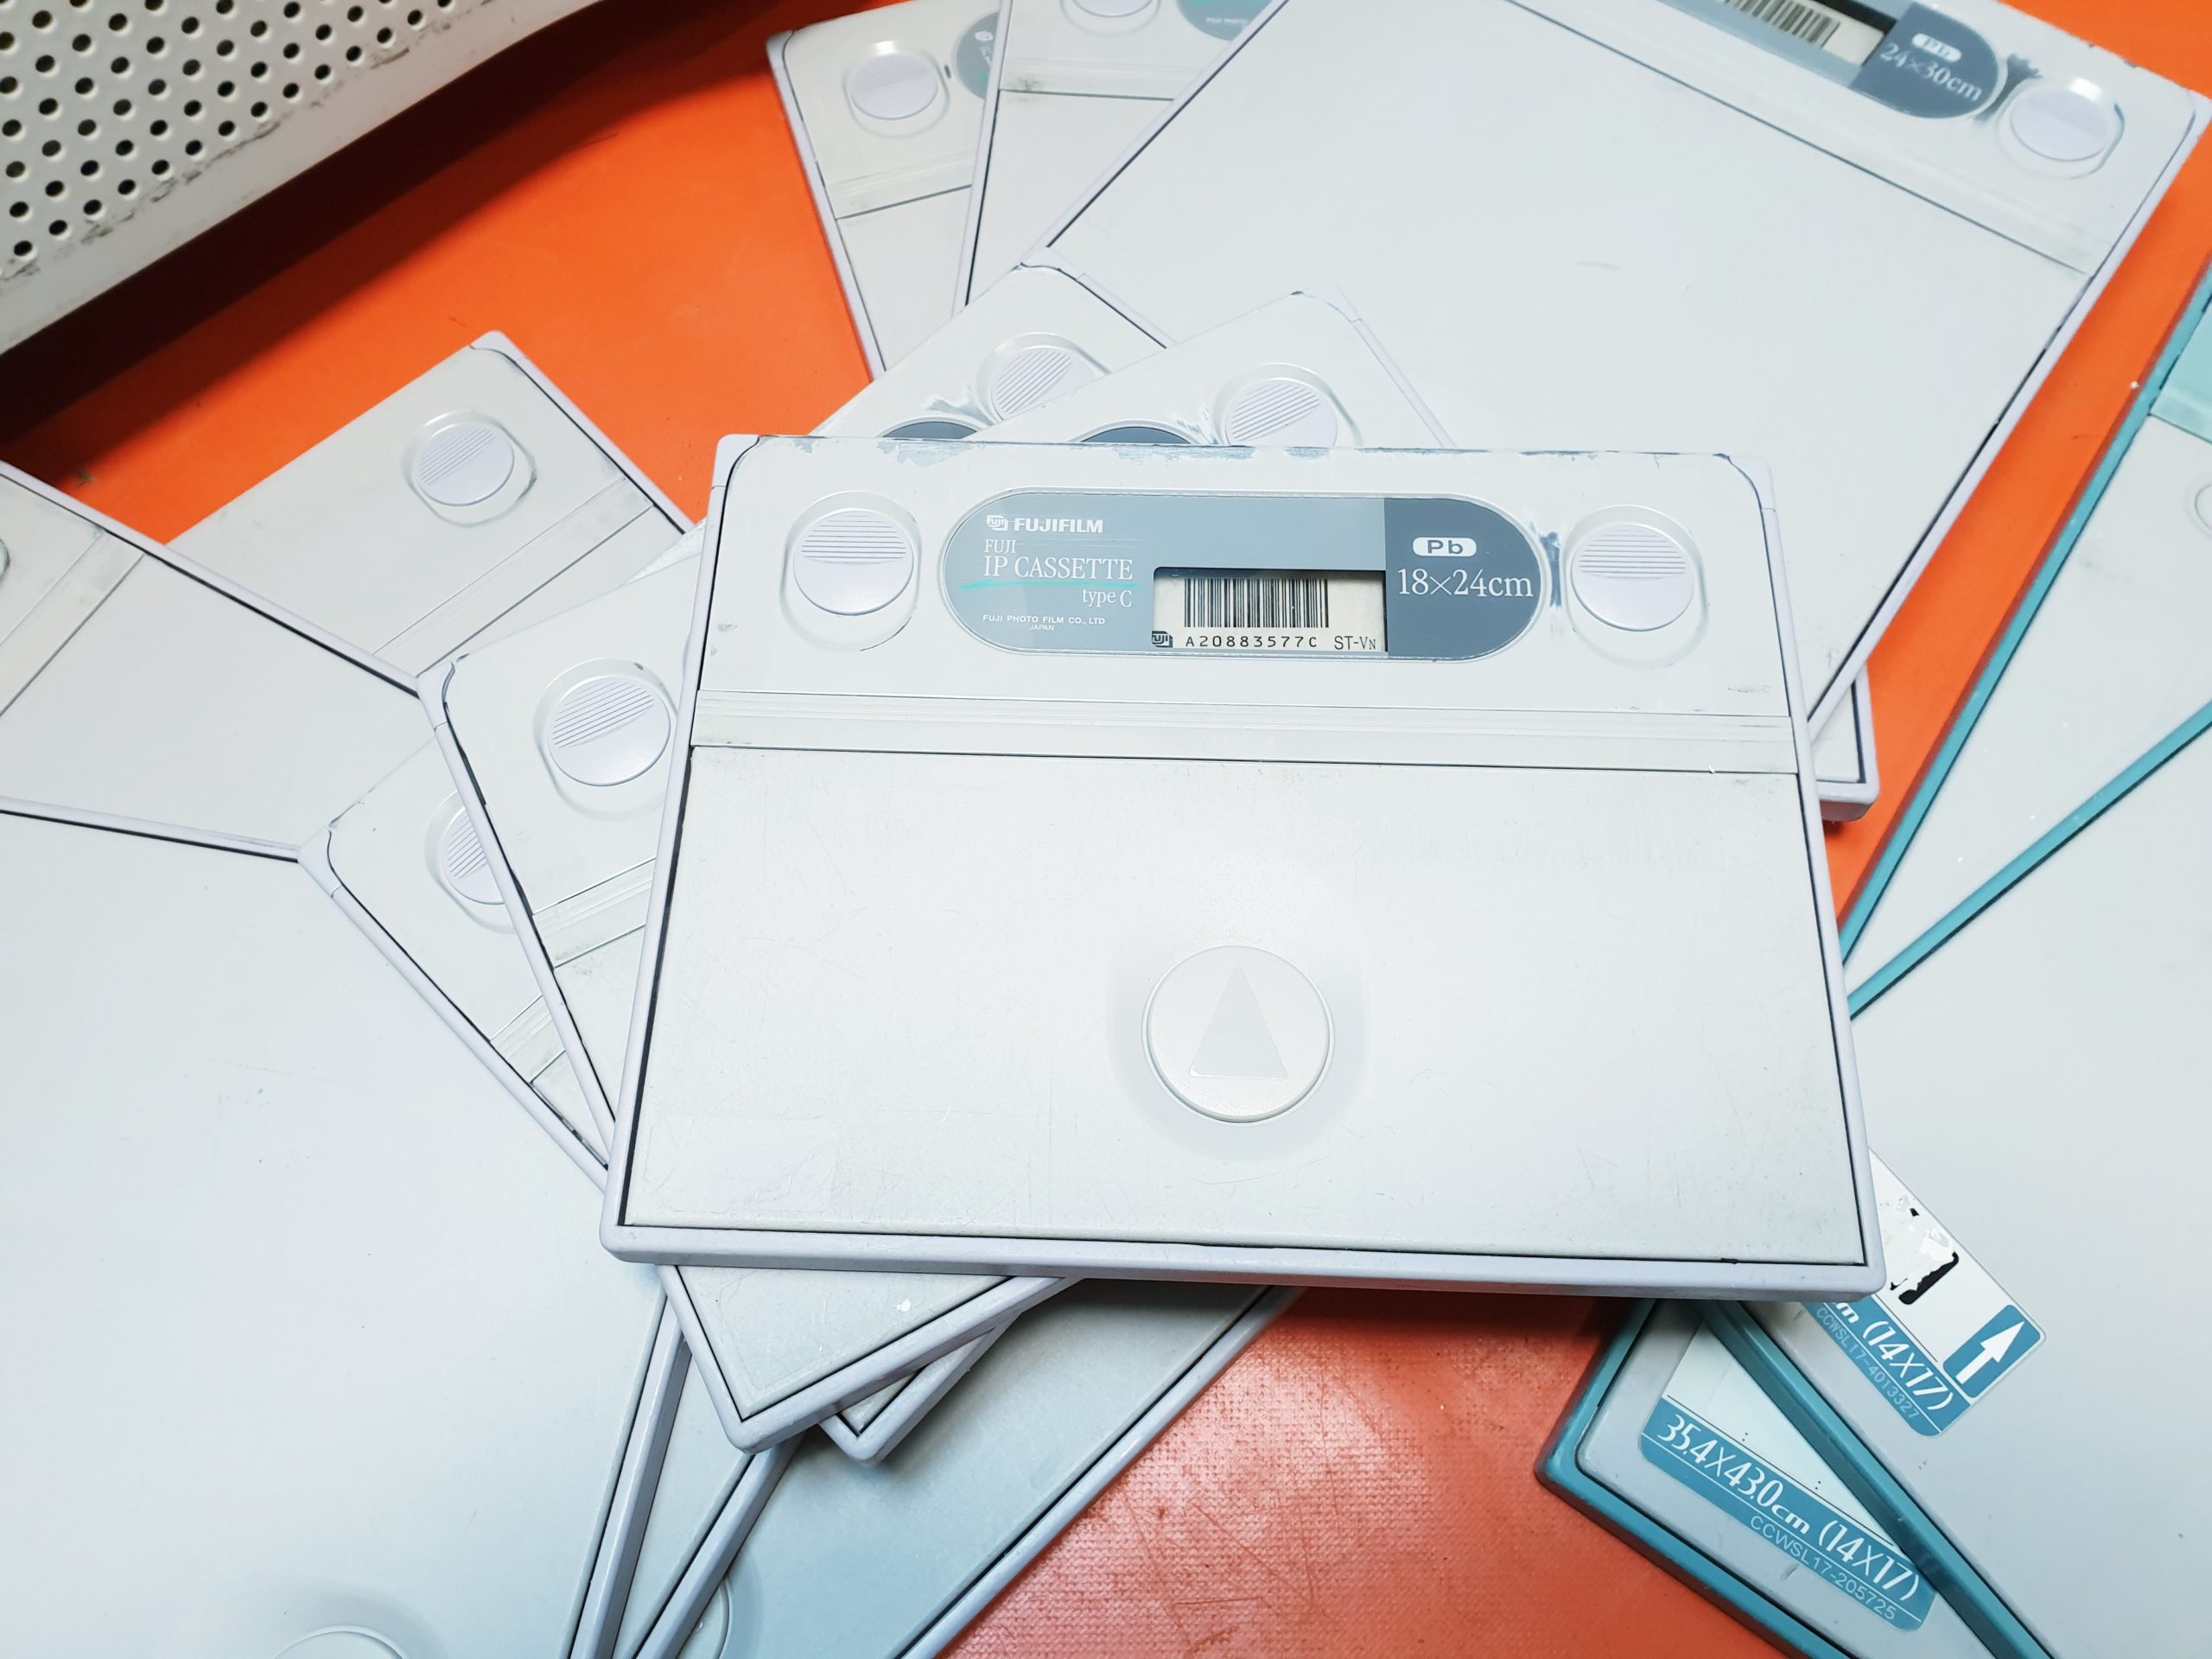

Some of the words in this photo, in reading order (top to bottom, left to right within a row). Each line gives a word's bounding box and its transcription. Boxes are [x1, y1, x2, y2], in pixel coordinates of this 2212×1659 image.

[1014, 518, 1103, 533] FUJIFILM
[983, 538, 1017, 554] FUJI
[1427, 539, 1464, 555] Pb
[983, 555, 1008, 576] IP
[1014, 556, 1134, 580] CASSETTE
[1082, 588, 1116, 607] type
[1120, 589, 1133, 607] C
[1185, 636, 1318, 648] A20883577C
[1833, 1301, 1859, 1324] m
[1816, 1306, 1921, 1419] CCWSL17-4013327
[1656, 1414, 1811, 1535] 35.4X43.0cm
[1817, 1520, 1920, 1601] (14X17)
[1750, 1516, 1897, 1621] CCWSL17-205725
